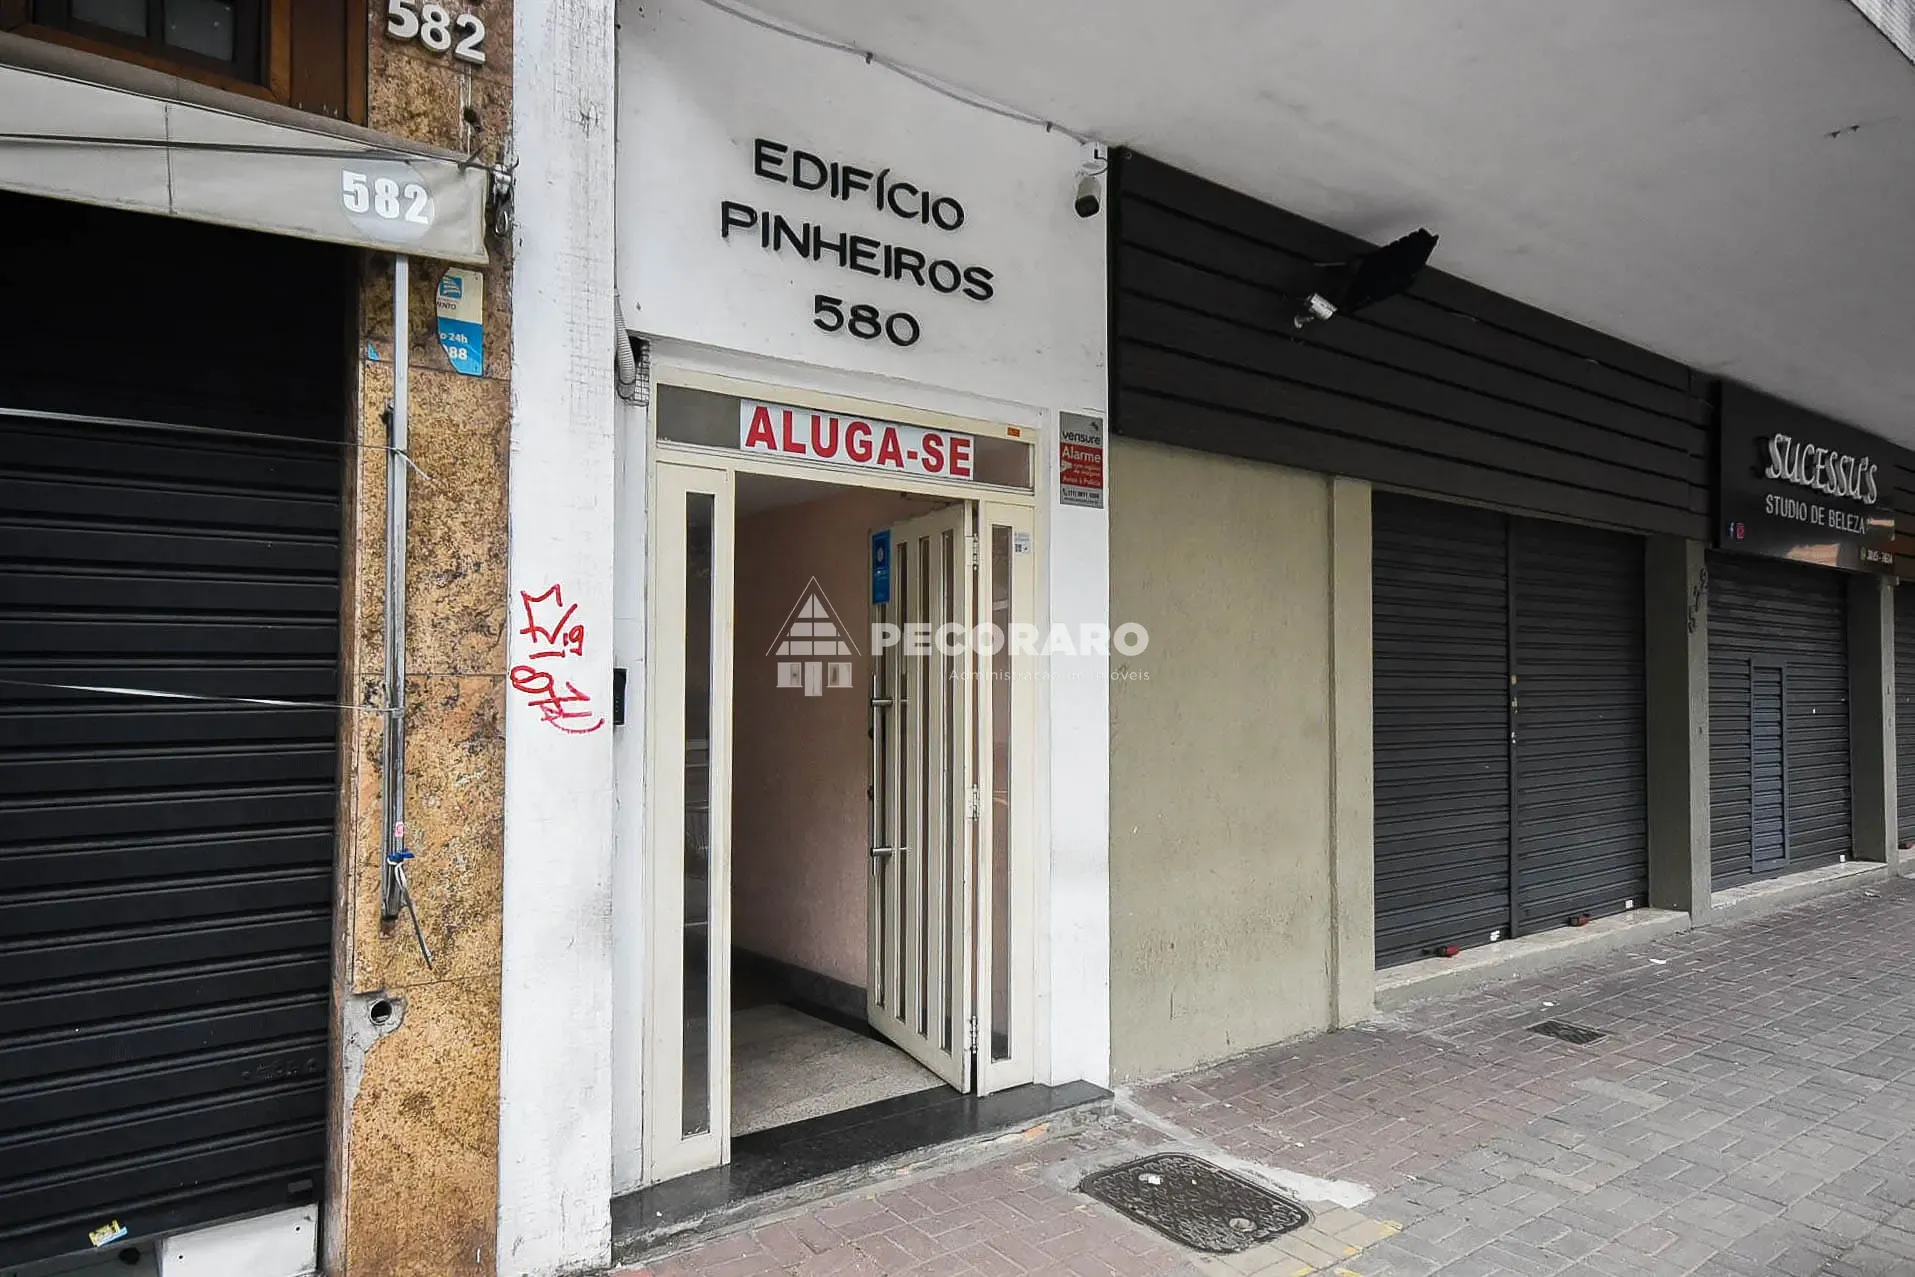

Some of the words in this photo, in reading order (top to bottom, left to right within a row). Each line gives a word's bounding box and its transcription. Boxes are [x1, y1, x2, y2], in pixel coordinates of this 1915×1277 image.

[387, 0, 485, 64] 582
[341, 169, 429, 225] 582
[754, 138, 965, 231] EDIFÍCIO
[721, 201, 994, 301] PINHEIROS
[813, 294, 921, 347] 580
[745, 405, 971, 477] ALUGA-SE
[1062, 446, 1101, 463] Alarme
[1766, 494, 1808, 521] STUDIO
[1811, 504, 1825, 526] DE
[1828, 509, 1866, 535] BELEZA
